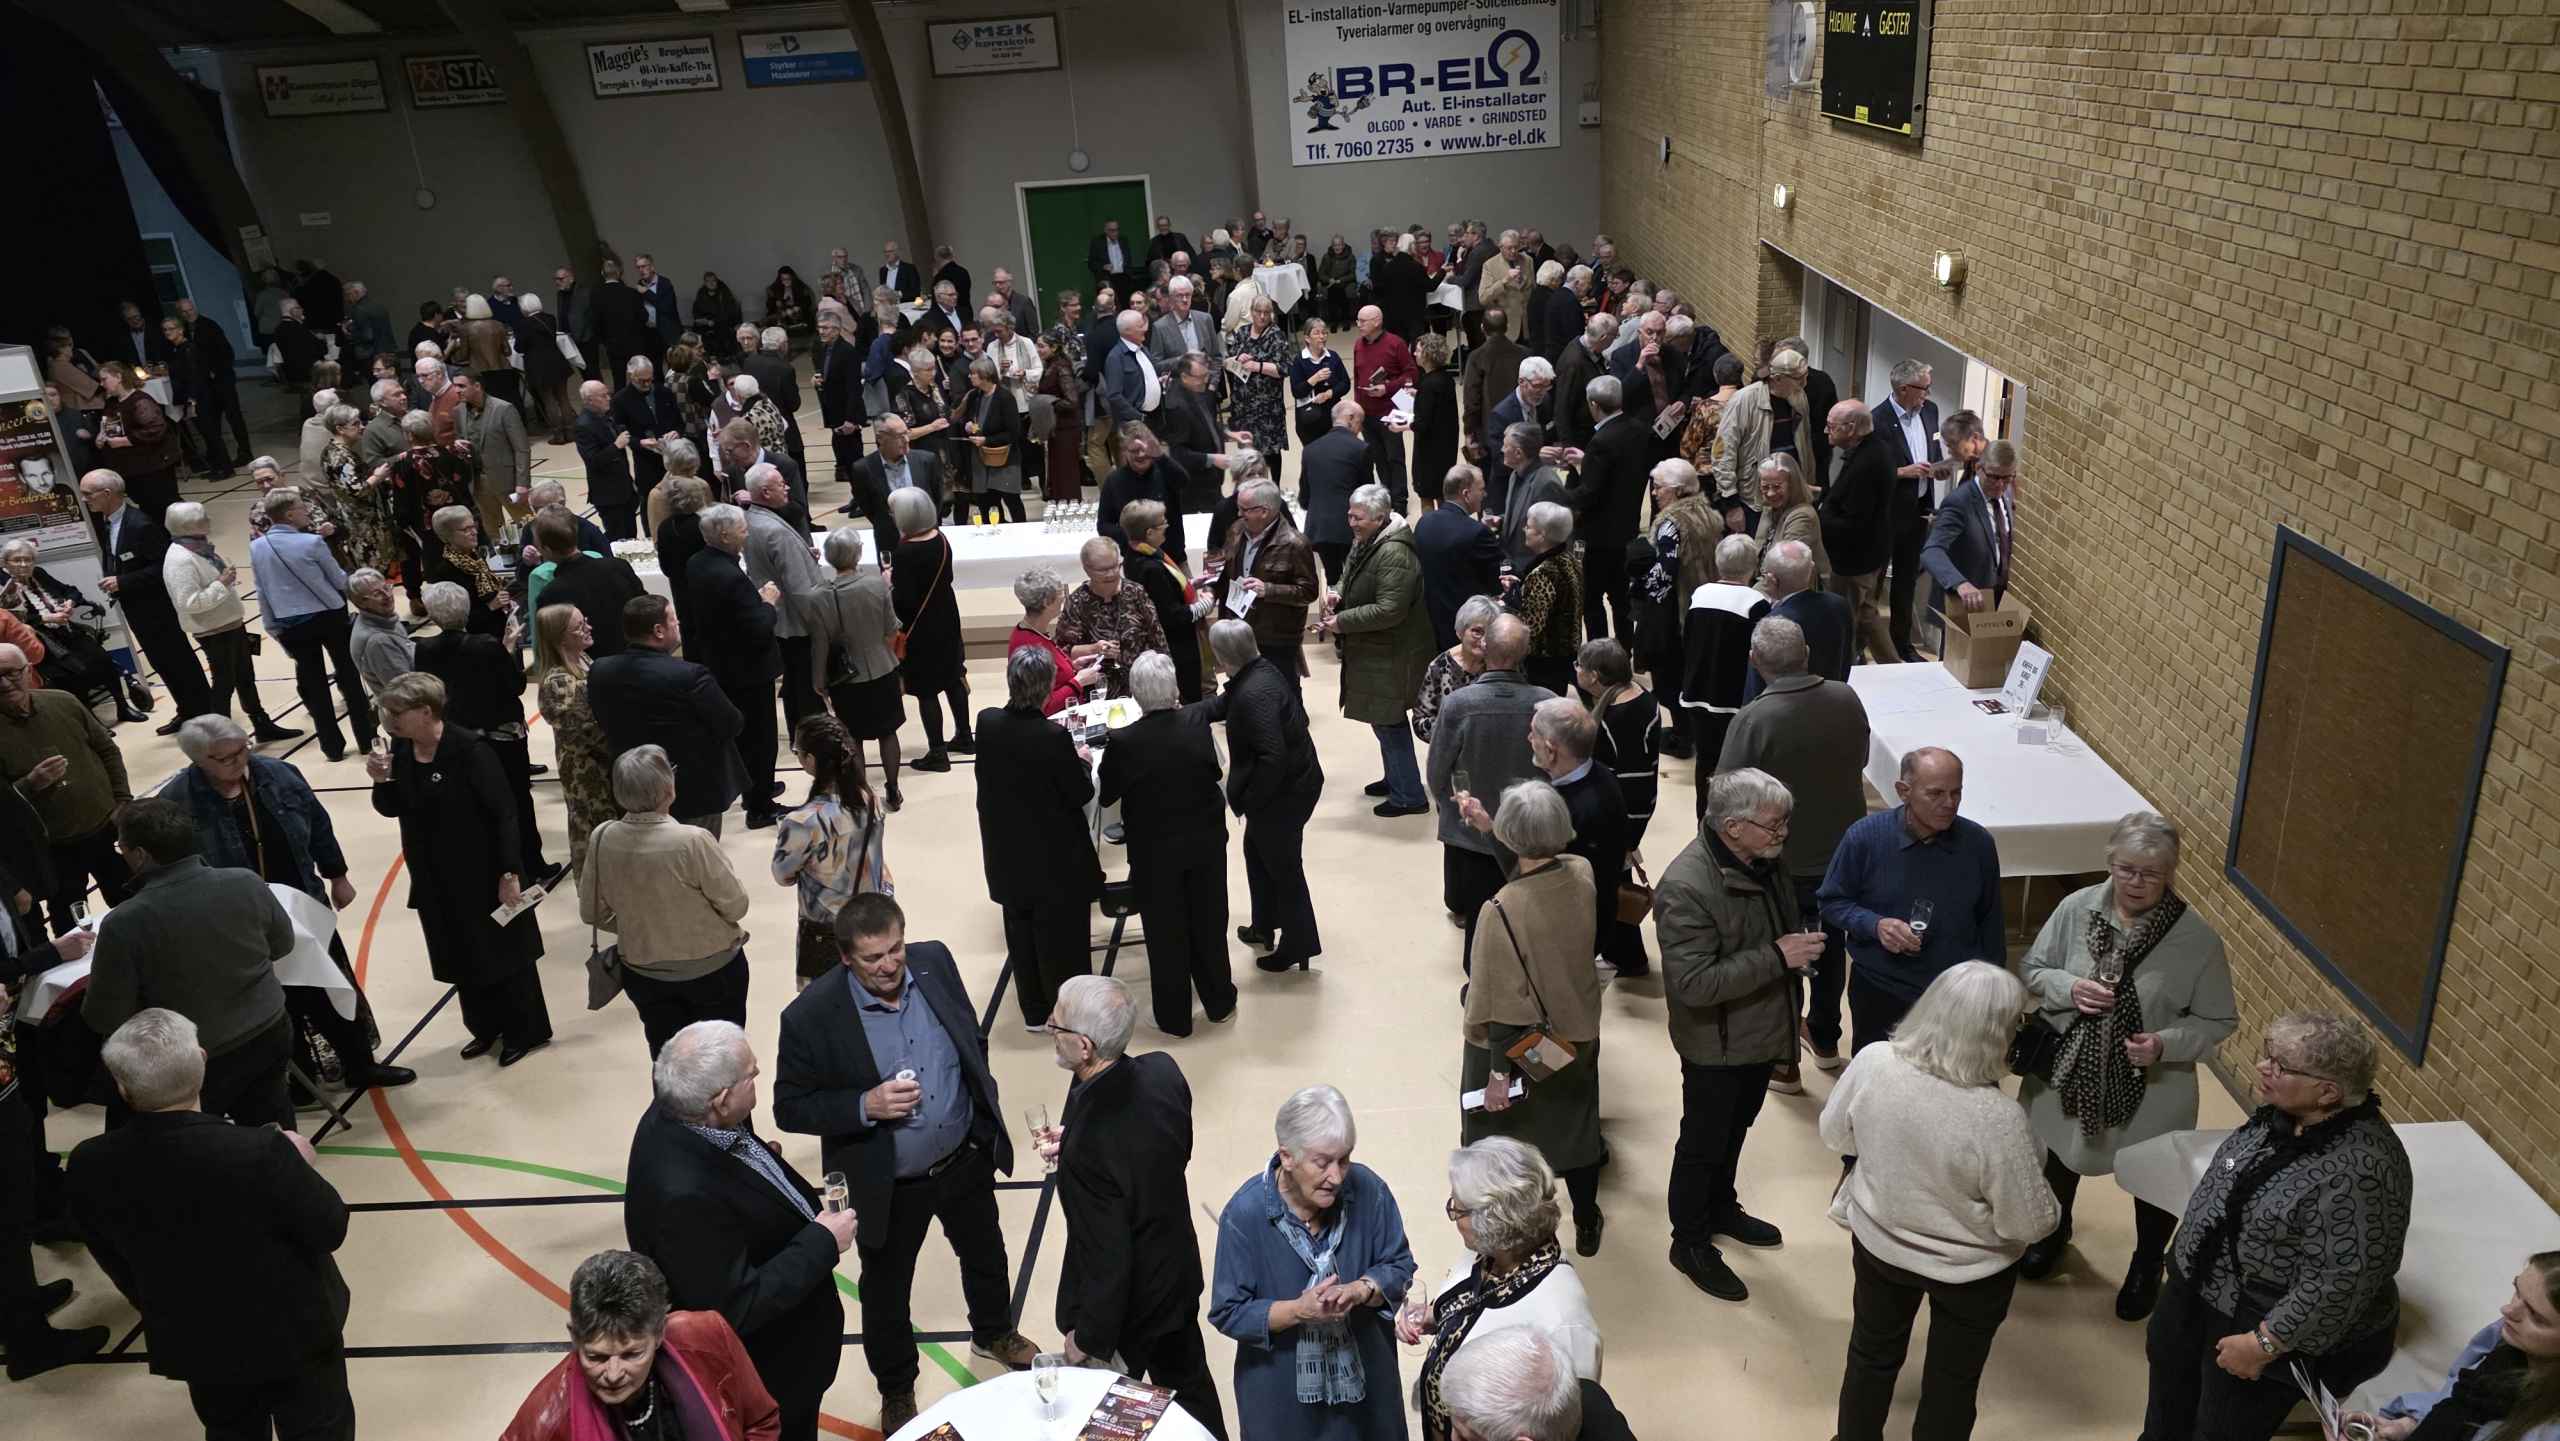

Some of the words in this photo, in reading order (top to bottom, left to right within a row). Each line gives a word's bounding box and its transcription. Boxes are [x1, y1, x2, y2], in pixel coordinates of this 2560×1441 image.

[974, 23, 1033, 37] M&K
[1336, 23, 1414, 42] Tyverialarmer
[1417, 22, 1431, 36] og
[1435, 15, 1506, 32] overvågning
[1828, 10, 1857, 33] HJEMME
[1879, 10, 1911, 35] GÆSTER
[592, 44, 649, 73] Maggie's
[447, 61, 496, 88] STA
[1402, 100, 1436, 113] Aut.
[1442, 92, 1547, 111] El-installatør
[1367, 120, 1406, 133] ØLGOD
[1424, 116, 1463, 129] VARDE
[1482, 109, 1547, 125] GRINDSTED
[1306, 144, 1330, 160] Tlf.
[1335, 141, 1373, 158] 7060
[1377, 138, 1414, 155] 2735
[1441, 128, 1547, 150] www.br-el.dk
